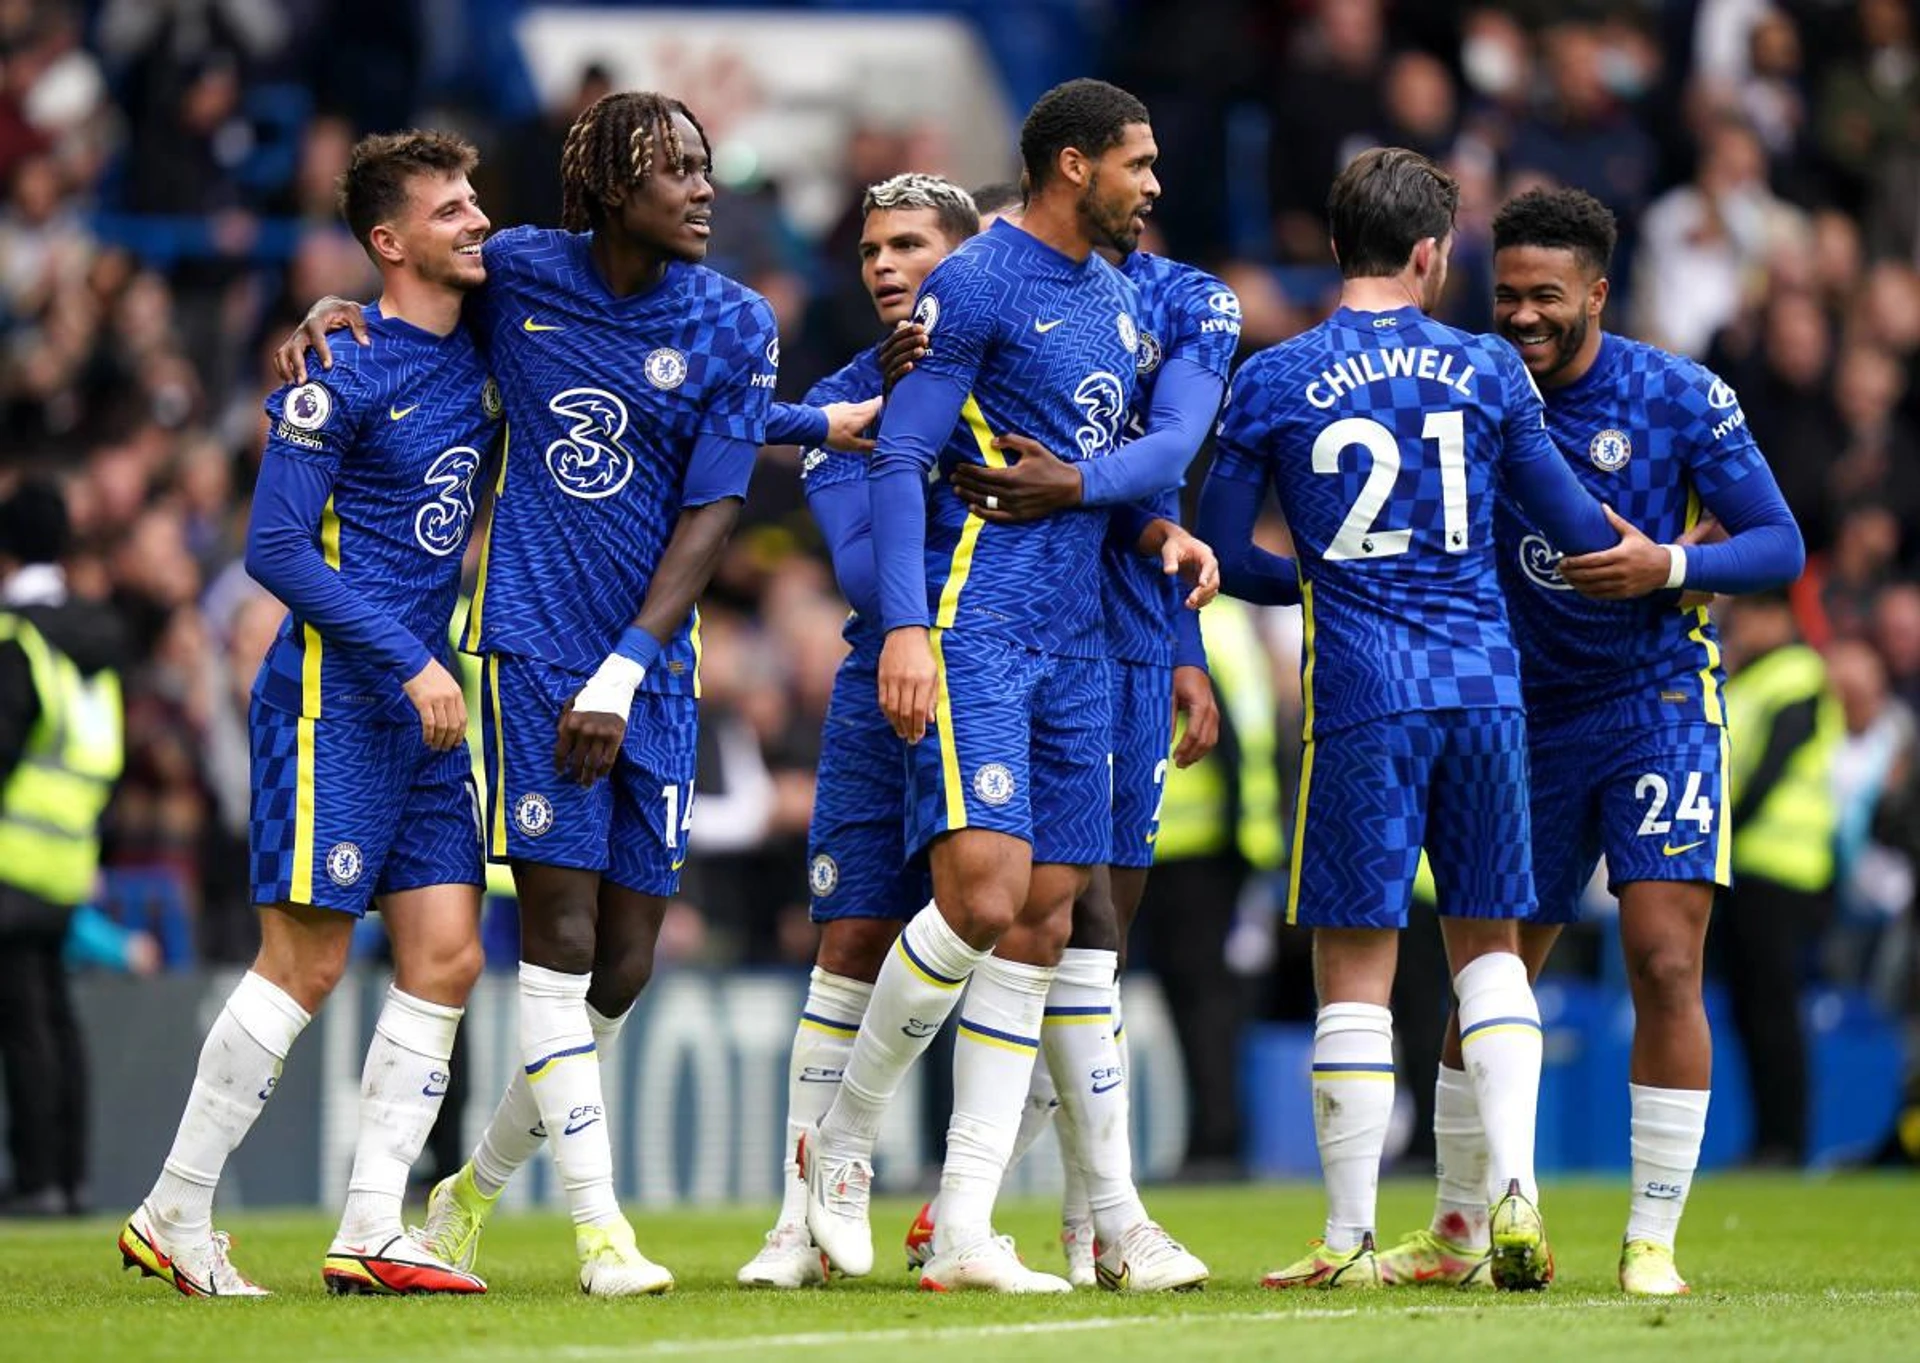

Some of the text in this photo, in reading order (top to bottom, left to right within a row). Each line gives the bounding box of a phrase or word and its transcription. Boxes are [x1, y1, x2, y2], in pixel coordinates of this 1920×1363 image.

[1372, 317, 1397, 328] CFC
[1305, 347, 1475, 409] CHILWELL
[546, 388, 634, 499] 3
[415, 446, 480, 556] 3
[1312, 410, 1468, 560] 21
[1635, 771, 1714, 837] 24
[569, 1105, 602, 1120] CFC
[1646, 1182, 1682, 1194] CFC
